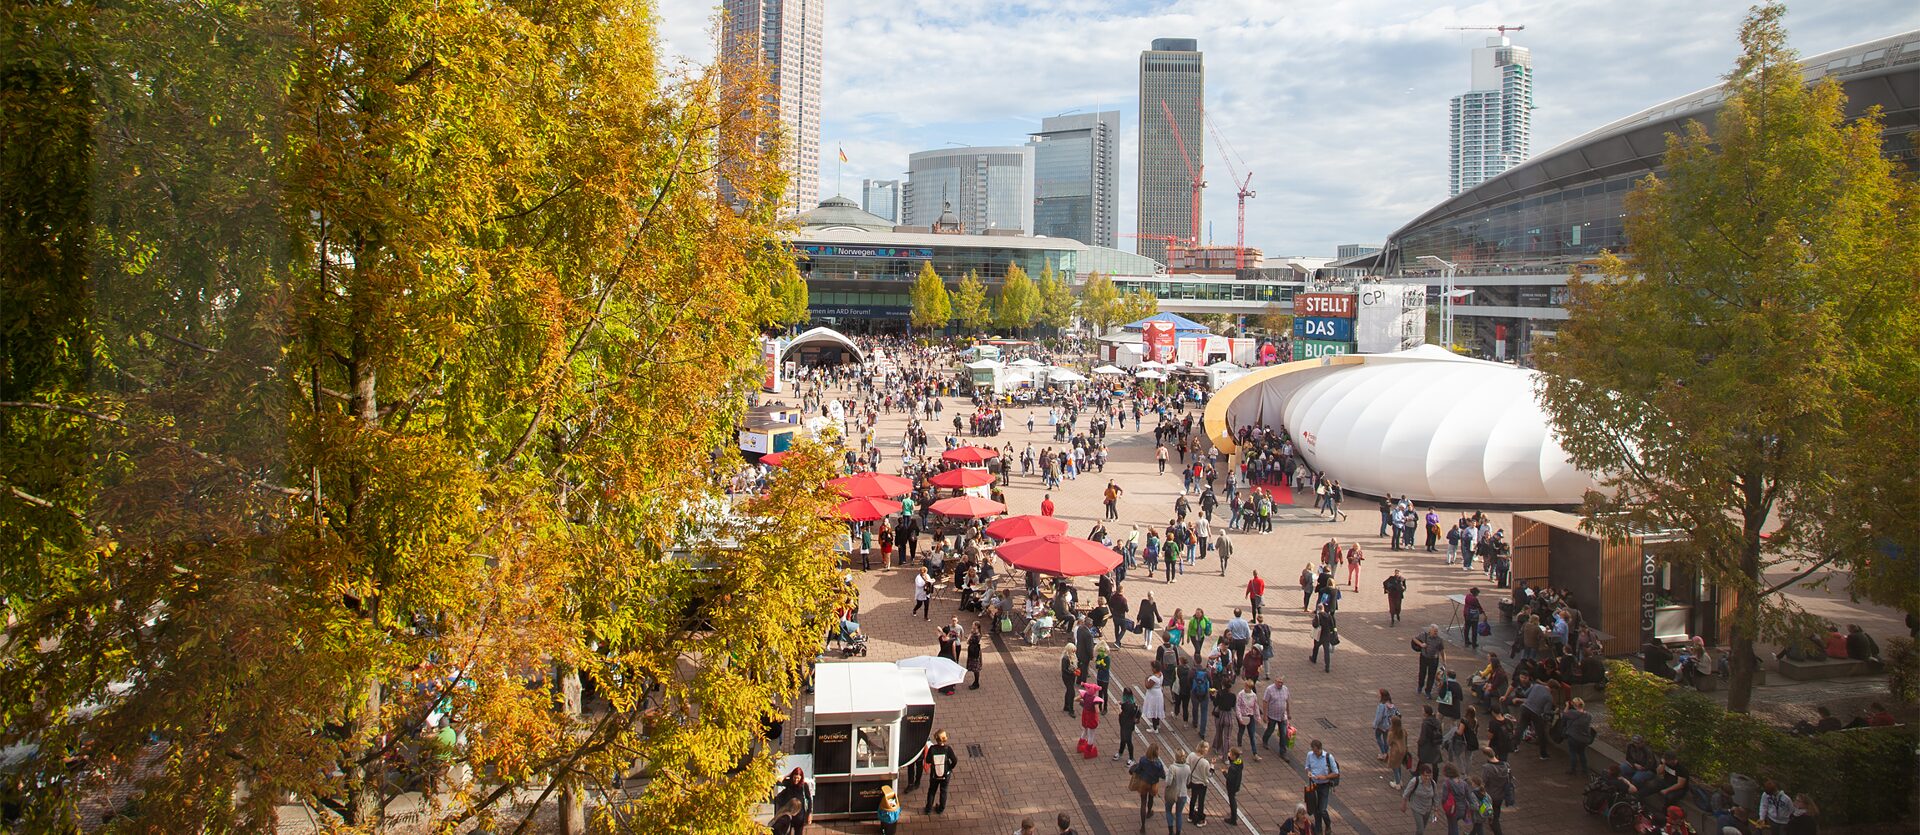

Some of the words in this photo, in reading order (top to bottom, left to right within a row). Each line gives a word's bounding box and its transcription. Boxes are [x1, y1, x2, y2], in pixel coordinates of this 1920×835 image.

[1306, 297, 1349, 312] STELLT
[1305, 320, 1335, 336] DAS
[1305, 343, 1345, 358] BUCH
[1642, 554, 1656, 586] Box
[1642, 592, 1655, 631] Café
